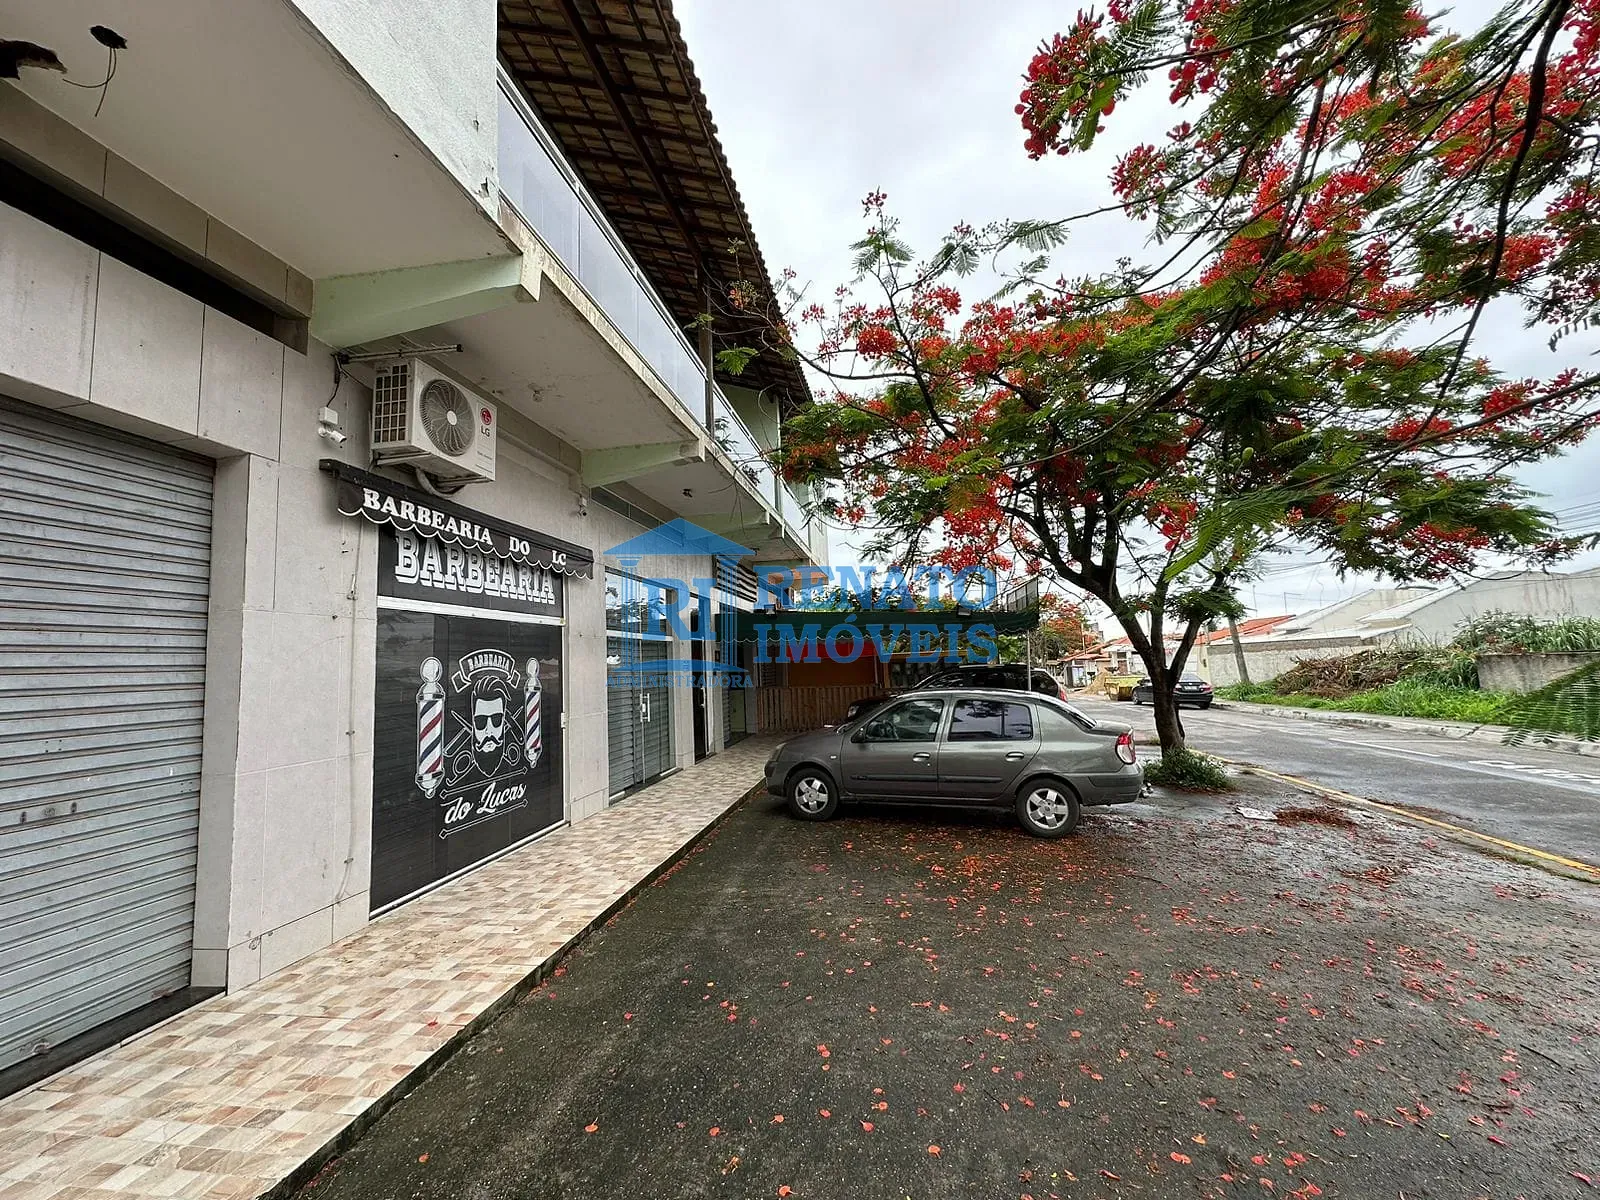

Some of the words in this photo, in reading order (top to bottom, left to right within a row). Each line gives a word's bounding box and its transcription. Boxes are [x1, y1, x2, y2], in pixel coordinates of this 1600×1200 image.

[480, 425, 491, 438] LG
[363, 488, 493, 546] BARBEARIA
[509, 536, 531, 556] DO
[395, 533, 556, 605] BARBEARIA
[467, 653, 510, 672] BARBEARIA
[440, 796, 474, 824] do
[476, 780, 527, 814] Lucas
